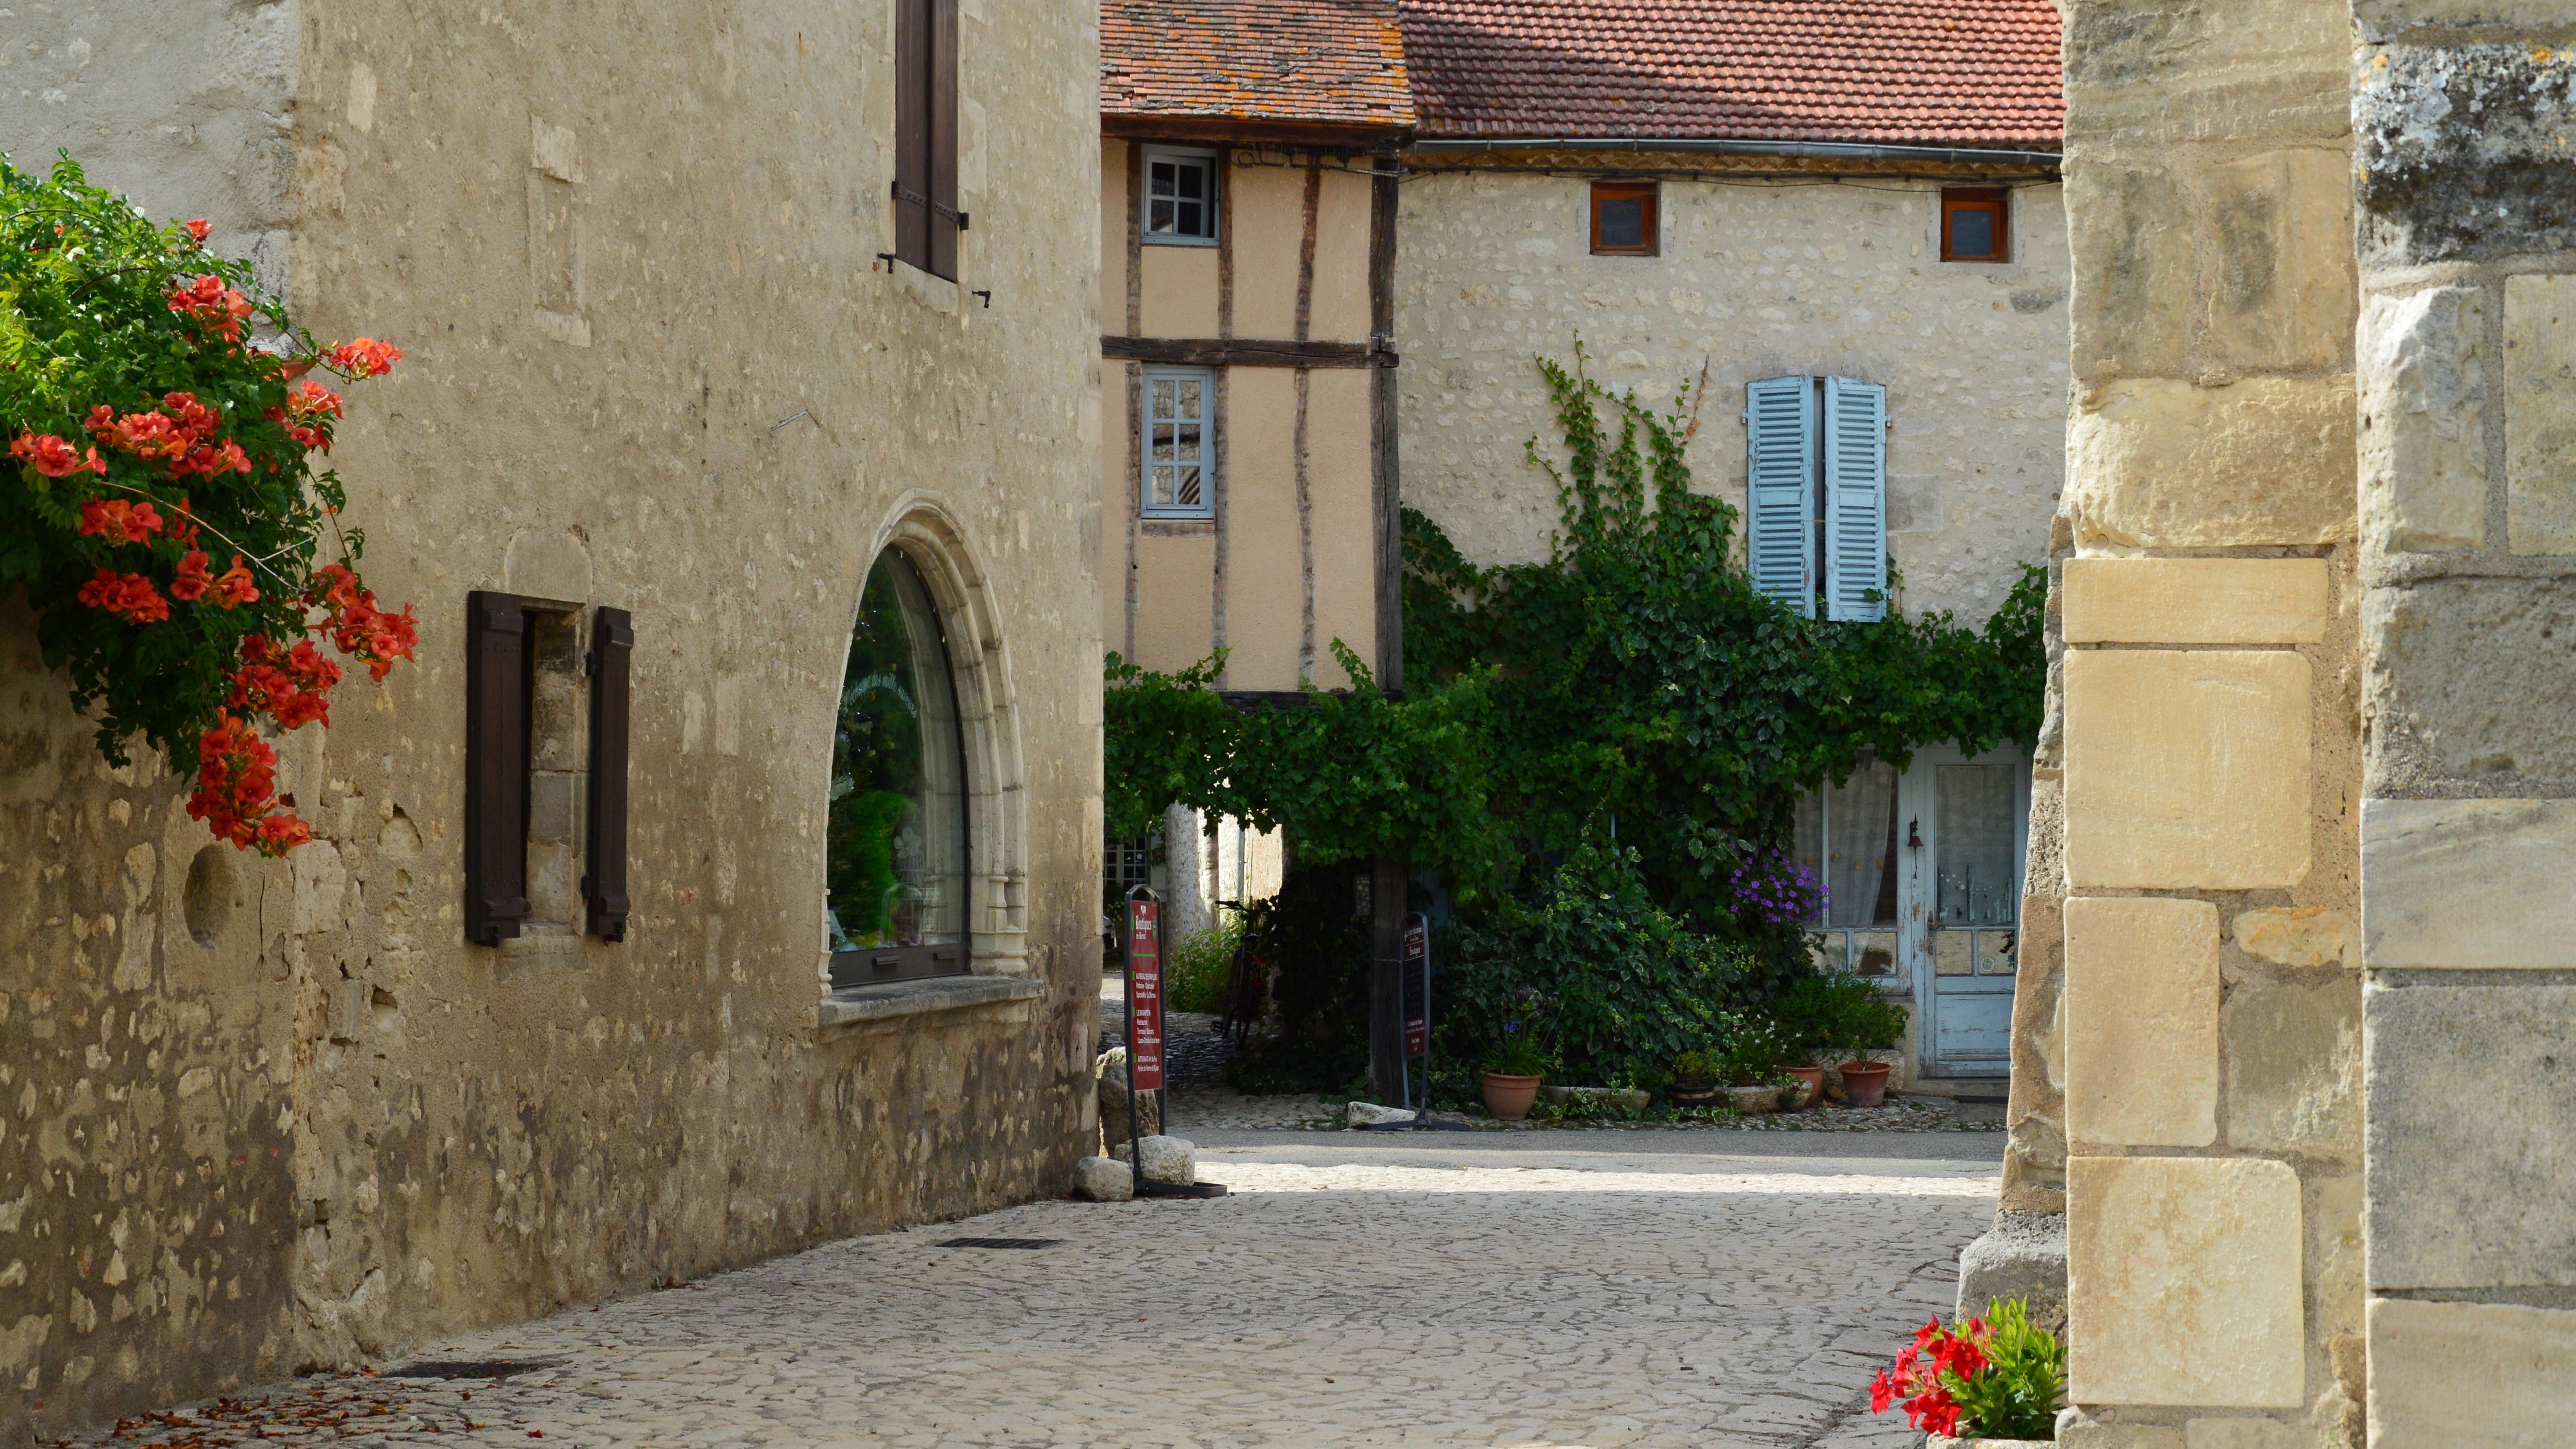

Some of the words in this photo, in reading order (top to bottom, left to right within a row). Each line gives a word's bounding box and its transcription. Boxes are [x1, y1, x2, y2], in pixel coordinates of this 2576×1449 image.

[871, 670, 880, 687] des
[882, 672, 897, 692] mille
[897, 686, 917, 719] saveurs
[1136, 915, 1152, 933] Boutiques
